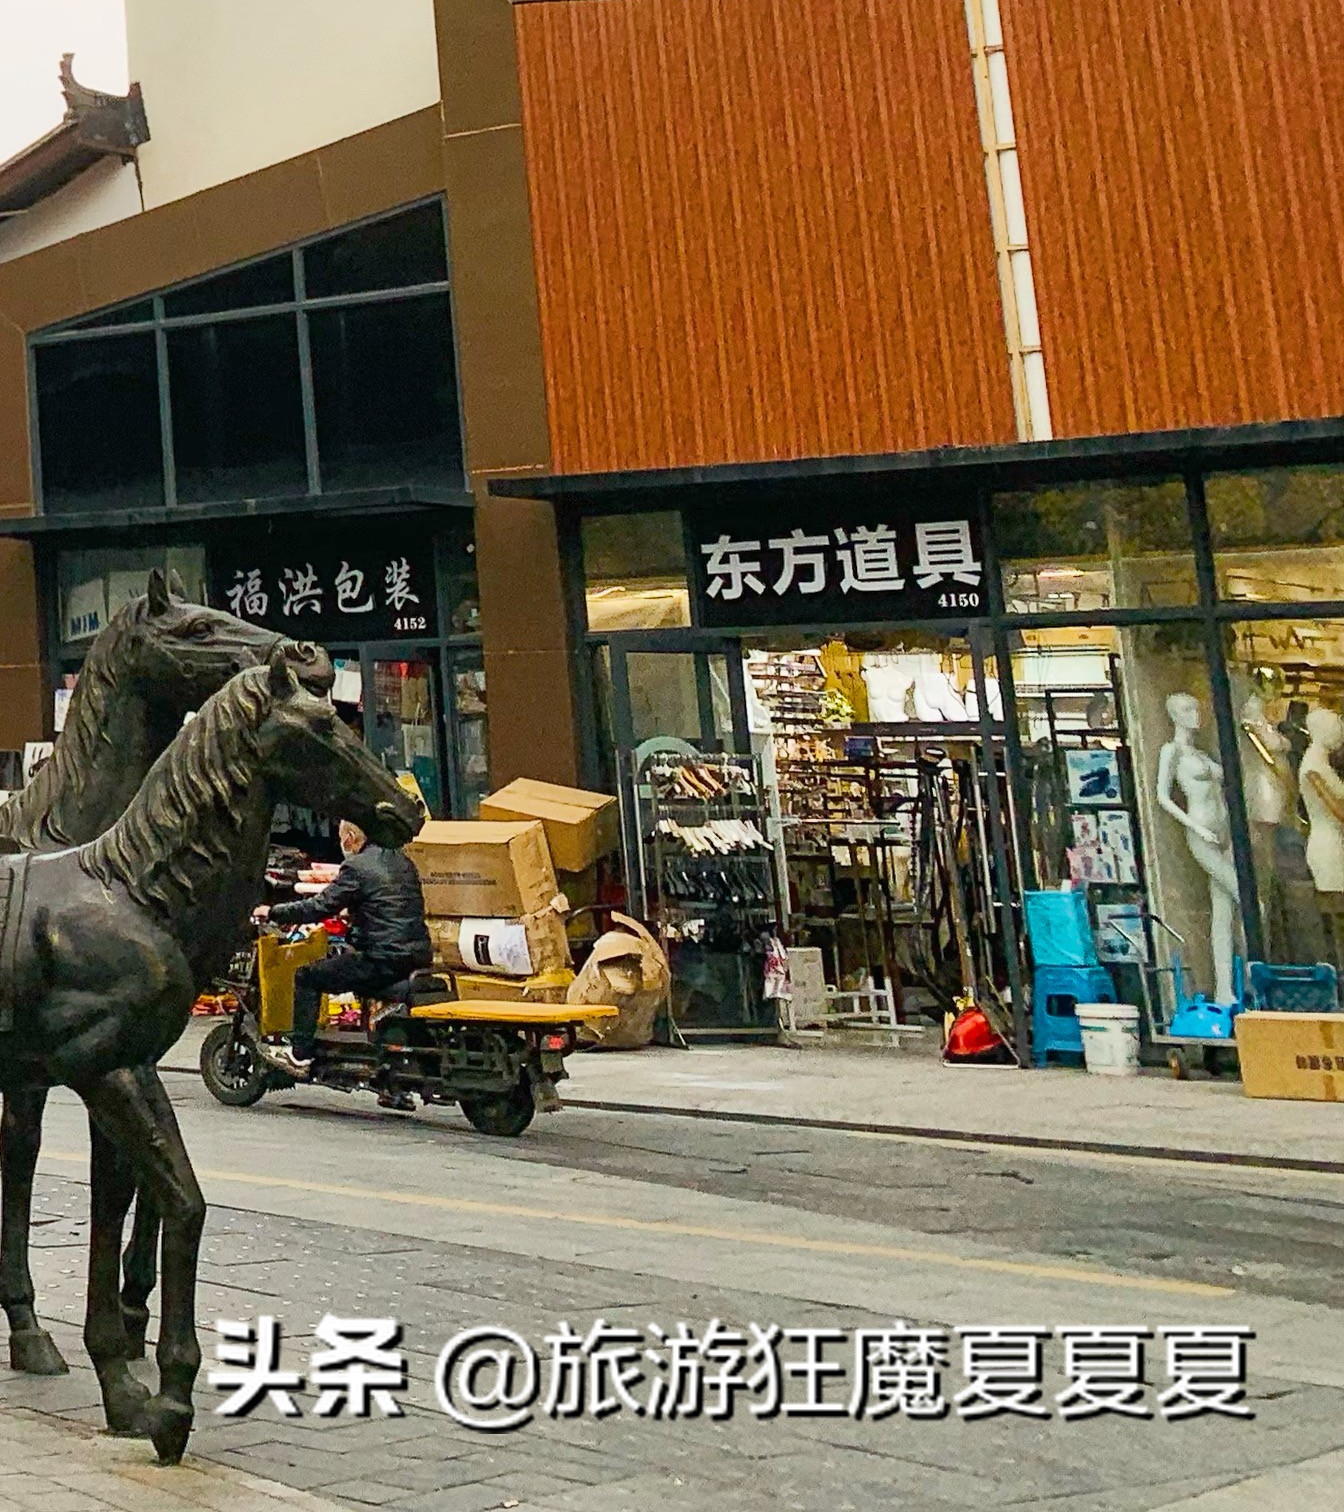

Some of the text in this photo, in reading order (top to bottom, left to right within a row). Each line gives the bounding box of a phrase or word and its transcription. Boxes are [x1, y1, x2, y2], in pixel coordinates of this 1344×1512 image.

[700, 519, 982, 600] 东方道具
[225, 557, 420, 618] 福洪包装
[937, 592, 980, 608] 4150
[393, 616, 427, 631] 4152
